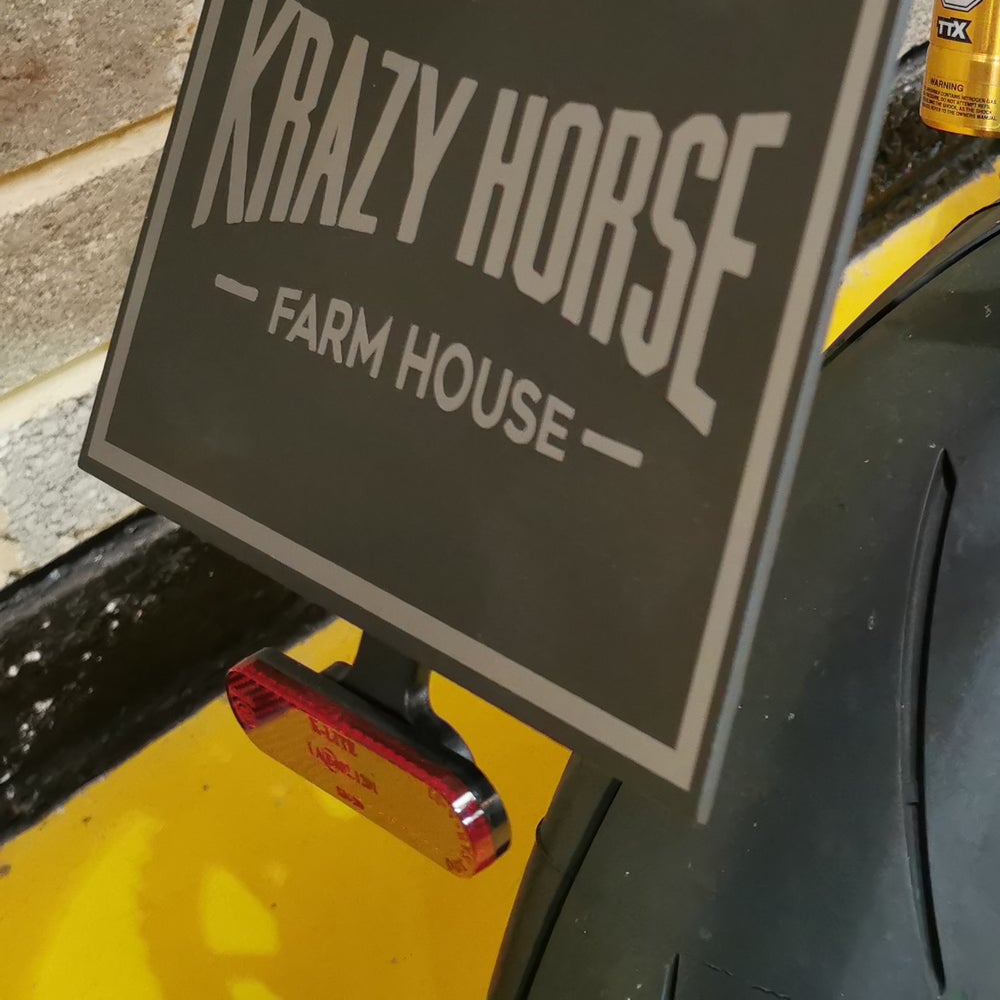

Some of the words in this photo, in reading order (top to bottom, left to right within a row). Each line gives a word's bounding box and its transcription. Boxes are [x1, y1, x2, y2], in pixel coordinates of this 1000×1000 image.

[938, 18, 968, 41] TTX
[930, 78, 964, 92] WARNING
[455, 88, 792, 437] HORSE
[267, 285, 394, 379] FARM
[394, 324, 576, 463] HOUSE
